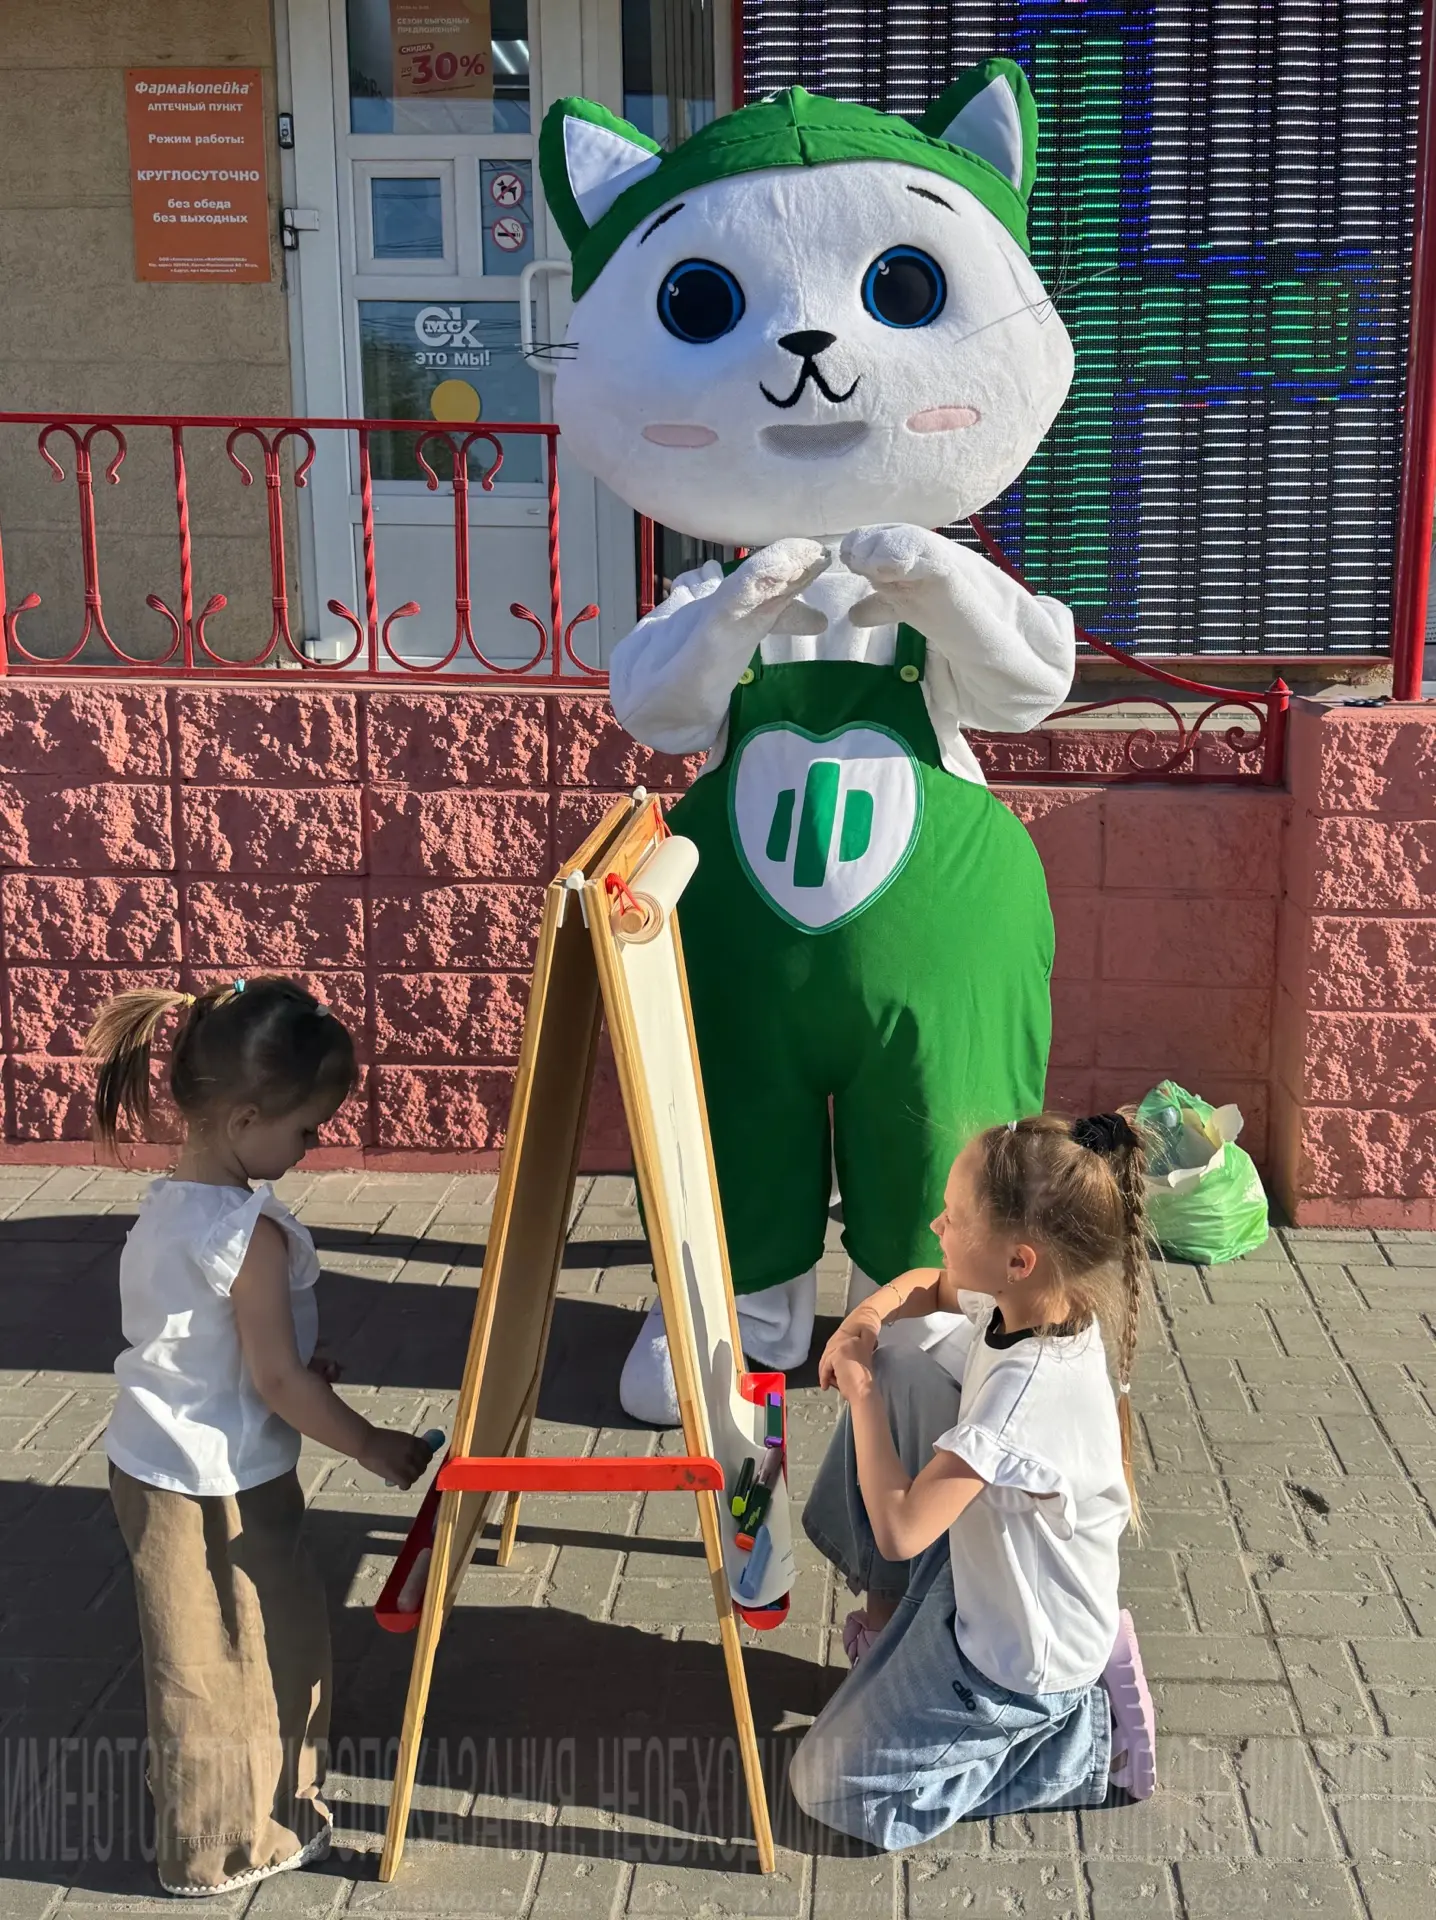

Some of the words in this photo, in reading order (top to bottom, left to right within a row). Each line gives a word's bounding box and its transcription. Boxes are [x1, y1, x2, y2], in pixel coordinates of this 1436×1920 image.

[401, 44, 432, 53] СКИДКА
[135, 81, 249, 96] Фармакопейка
[147, 102, 206, 112] АПТЕЧНЫЙ
[209, 103, 244, 112] ПУНКТ
[148, 133, 191, 144] Режим
[195, 134, 245, 145] работы:
[137, 170, 260, 182] КРУГЛОСУТОЧНО
[167, 199, 191, 209] без
[194, 199, 231, 210] обеда
[153, 212, 177, 223] без
[180, 214, 248, 224] выходных
